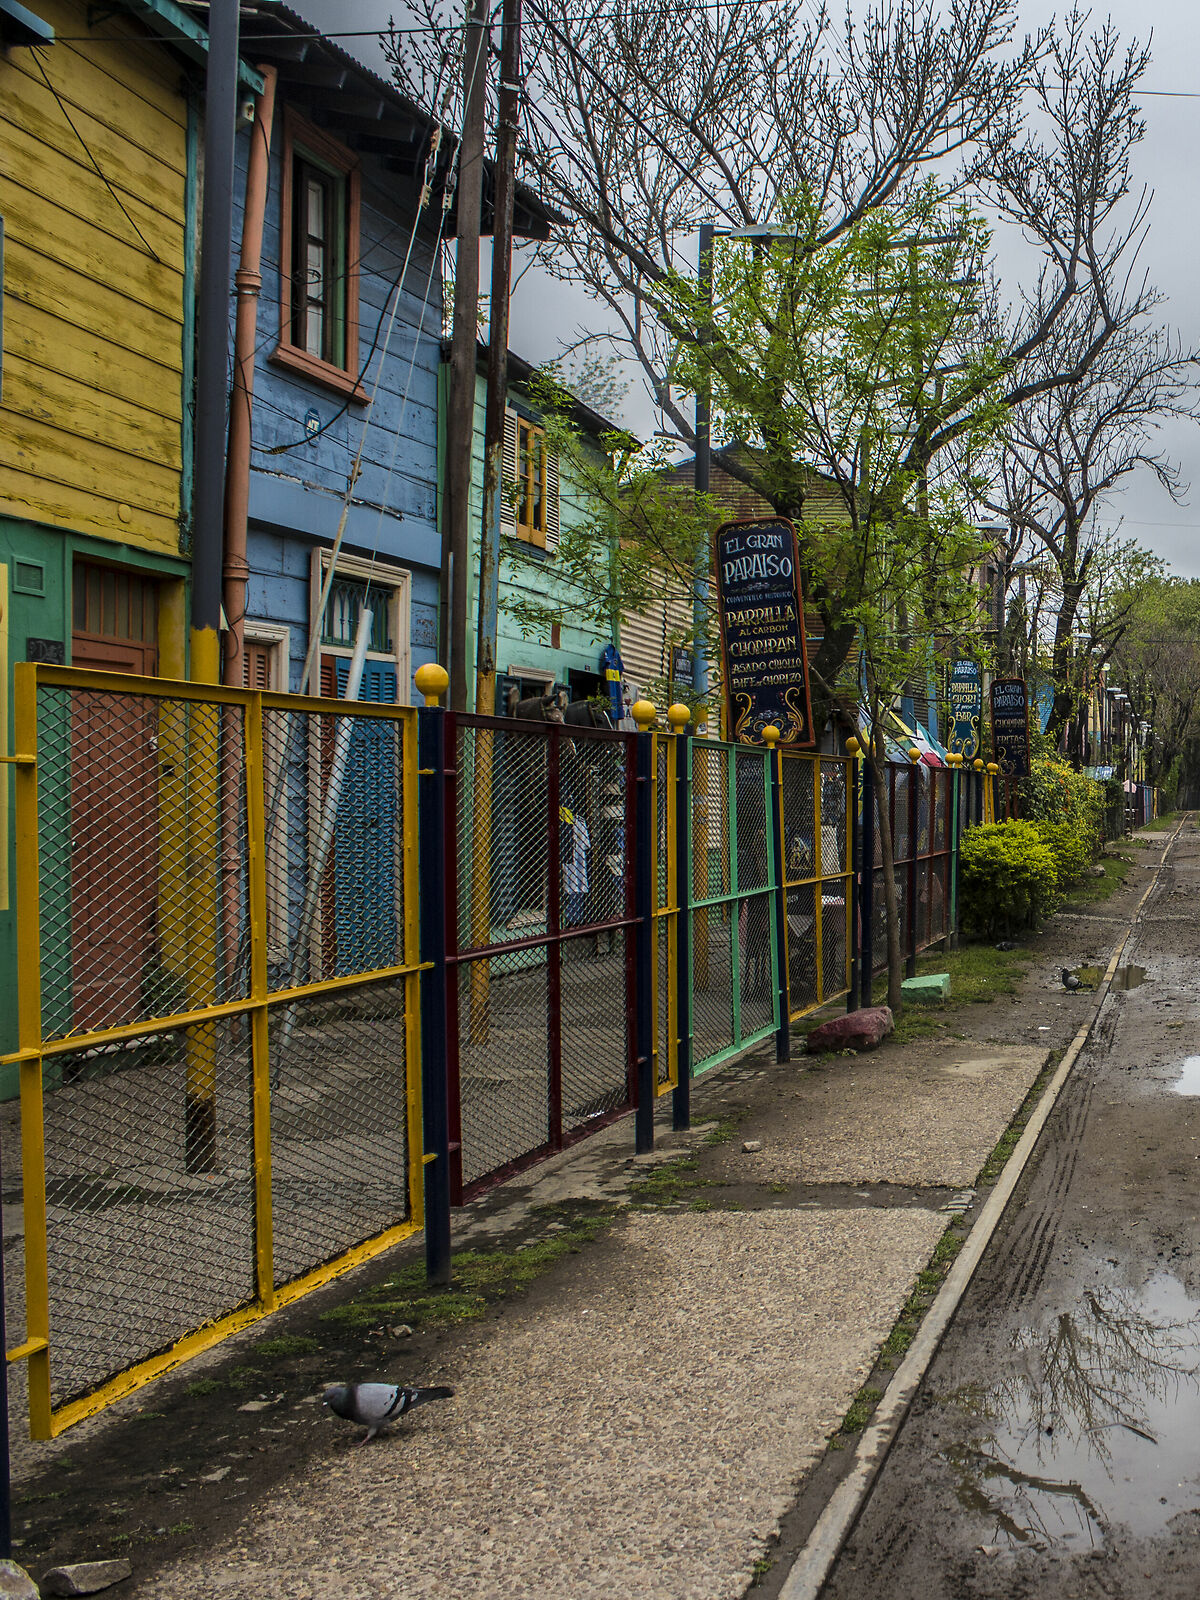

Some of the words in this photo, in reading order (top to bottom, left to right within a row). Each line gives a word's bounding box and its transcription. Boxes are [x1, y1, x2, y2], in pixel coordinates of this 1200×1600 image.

[724, 538, 745, 554] EL
[747, 534, 783, 549] GRAN
[723, 553, 792, 585] PARAISO
[725, 604, 795, 628] PARRILLA
[738, 629, 752, 637] AL
[729, 635, 797, 657] CHORIPAN
[731, 661, 767, 675] ASADO
[768, 657, 802, 670] CRIOLLO
[732, 677, 756, 689] BIFE
[762, 672, 802, 686] CHORIZO
[994, 685, 1004, 695] EL
[993, 694, 1025, 708] PARAISO
[955, 711, 972, 722] BAR
[996, 734, 1025, 745] FRITAS
